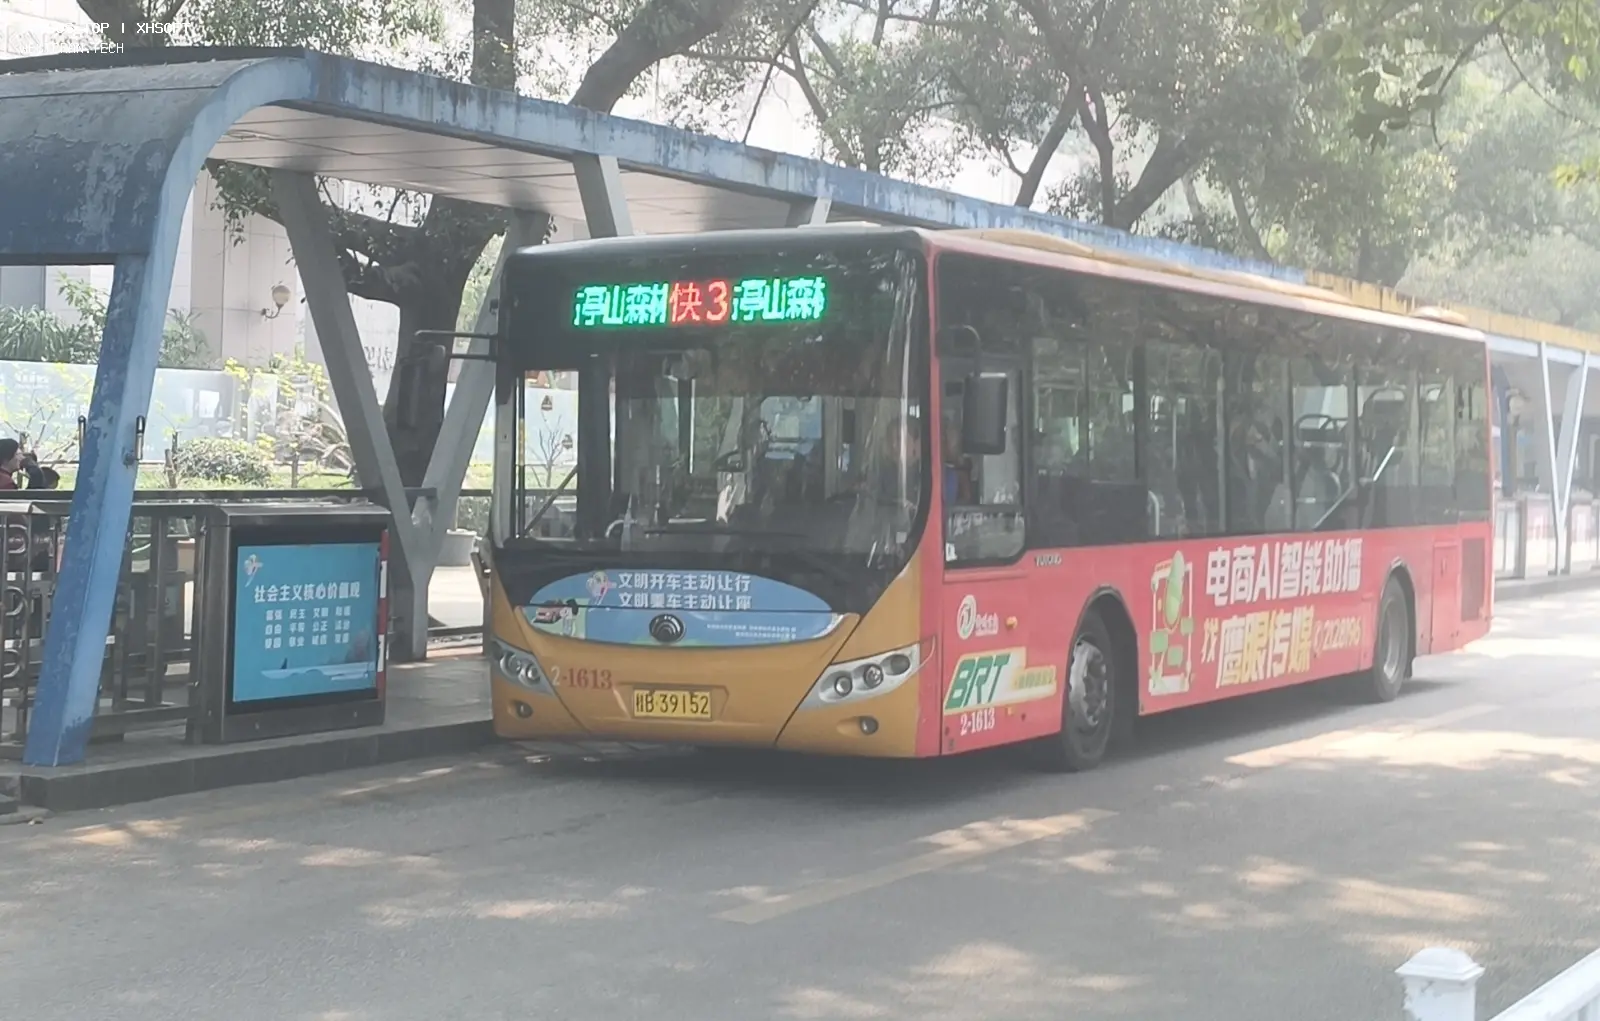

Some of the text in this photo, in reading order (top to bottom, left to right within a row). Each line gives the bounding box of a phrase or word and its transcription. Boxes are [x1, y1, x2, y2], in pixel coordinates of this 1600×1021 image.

[618, 572, 752, 592] 文明开车主动让行
[550, 665, 613, 690] 2-1613
[945, 653, 1011, 709] BRT
[960, 706, 996, 736] 2-1613
